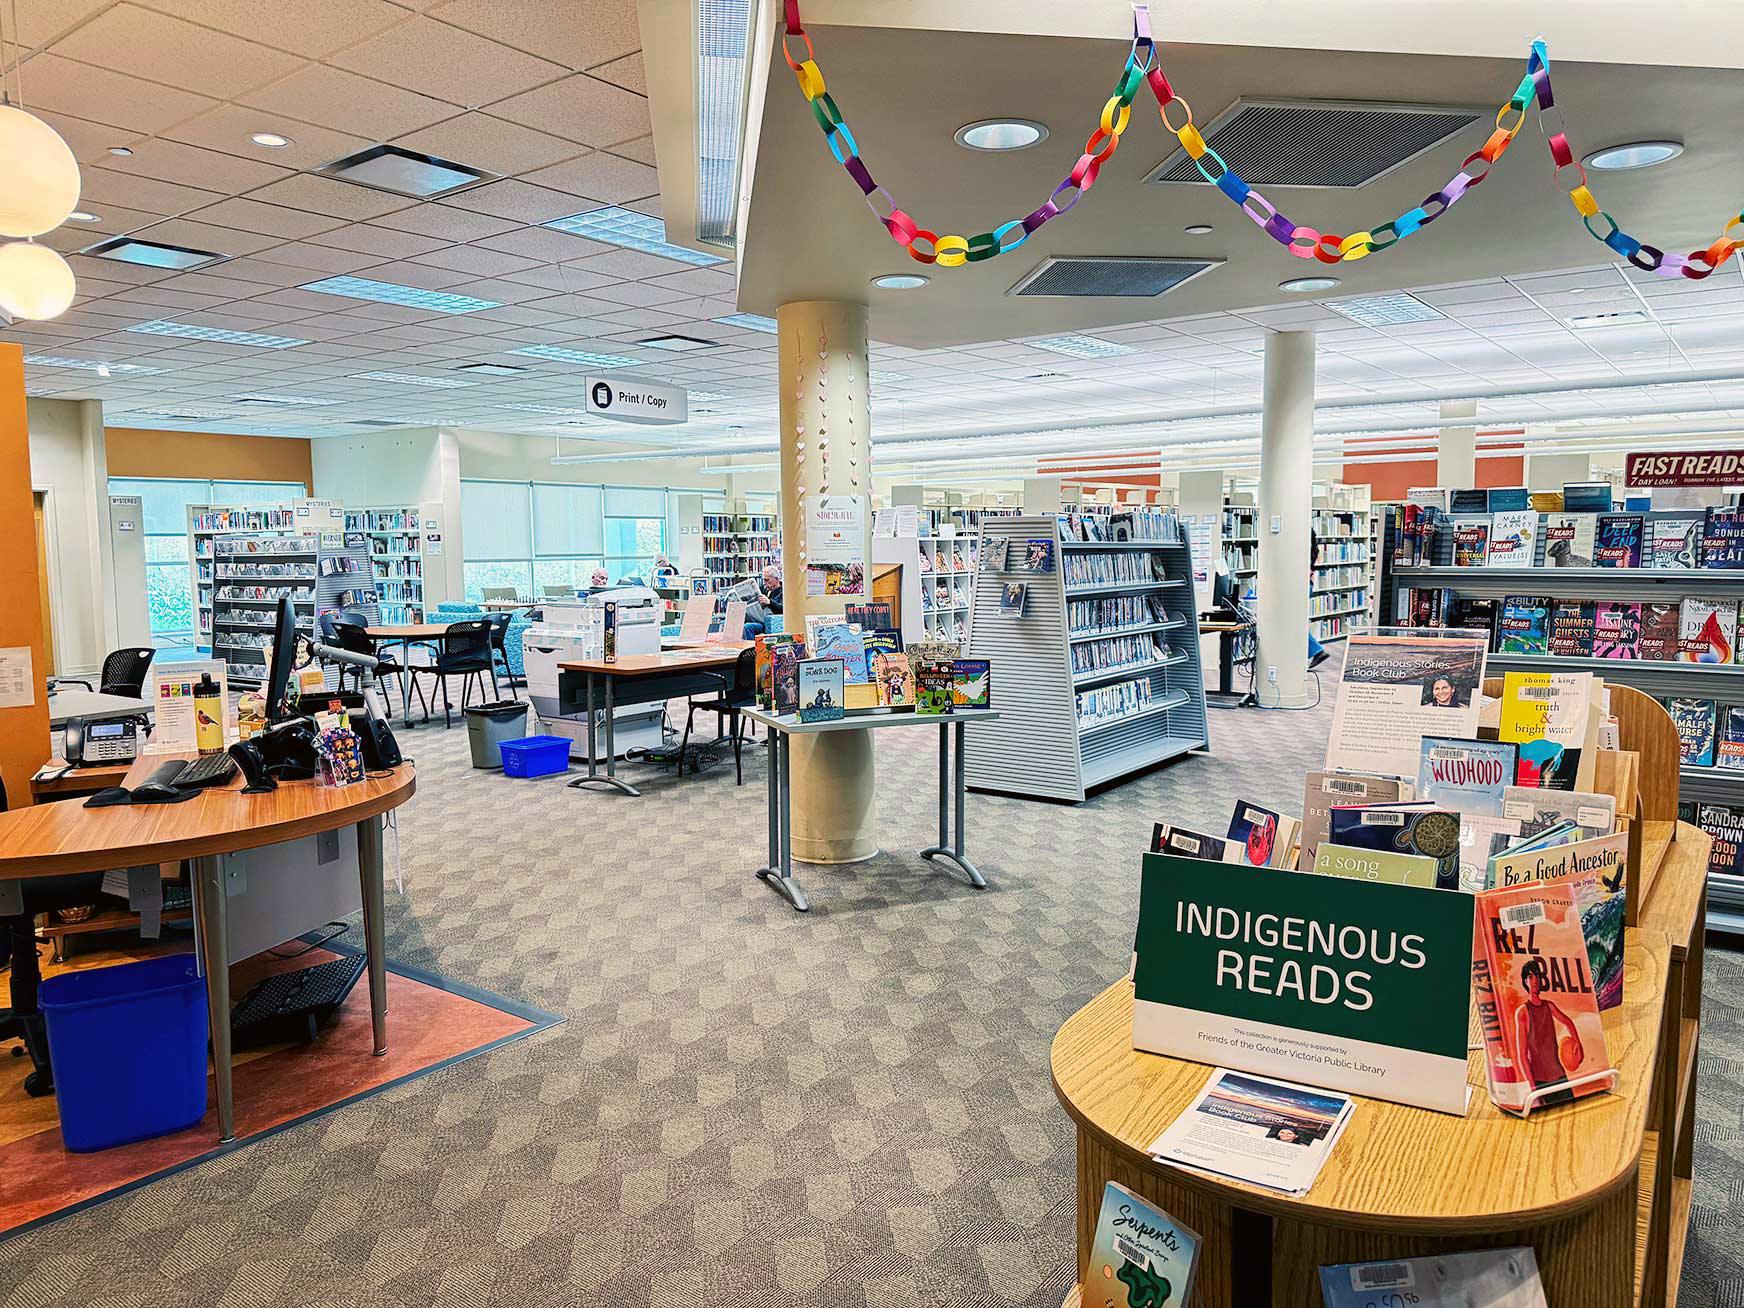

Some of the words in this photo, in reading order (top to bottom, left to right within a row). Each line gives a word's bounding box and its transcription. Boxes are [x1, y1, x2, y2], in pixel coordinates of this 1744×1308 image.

[619, 392, 640, 404] Print
[642, 394, 645, 404] /
[647, 395, 667, 408] Copy
[1631, 457, 1682, 475] FAST
[1681, 456, 1744, 474] READS
[1631, 477, 1638, 485] 7
[1733, 514, 1744, 522] RO
[1603, 524, 1640, 538] DEEP
[1610, 536, 1638, 548] END
[1568, 610, 1581, 618] THE
[1554, 618, 1593, 627] SUMMER
[1688, 622, 1734, 633] DRM
[1556, 628, 1589, 638] GUESTS
[824, 667, 838, 675] DOG
[1354, 658, 1411, 669] Indigenous
[1414, 660, 1450, 670] Stories
[1353, 668, 1380, 677] Book
[1382, 670, 1406, 678] Club
[1536, 702, 1560, 711] truth
[1541, 712, 1552, 723] &
[1677, 720, 1706, 728] MALFI
[1516, 723, 1545, 736] bright
[1548, 726, 1573, 734] water
[1678, 728, 1702, 736] URSE
[1431, 758, 1502, 785] WILDHOOD
[1701, 811, 1744, 829] SANDRA
[1712, 842, 1737, 854] OOD
[1321, 855, 1329, 867] a
[1335, 856, 1380, 879] song
[1504, 865, 1521, 886] Be
[1524, 871, 1531, 881] a
[1536, 858, 1566, 880] Good
[1570, 848, 1619, 874] Ancestor
[1176, 901, 1426, 969] INDIGENOUS
[1490, 917, 1540, 955] REZ
[1216, 950, 1374, 1011] READS
[1472, 959, 1493, 993] REZ
[1533, 956, 1592, 993] BALL
[1480, 1001, 1502, 1042] BALL
[1234, 1028, 1245, 1036] This
[1246, 1031, 1272, 1040] collection
[1279, 1037, 1309, 1048] generously
[1310, 1042, 1339, 1053] supported
[1198, 1032, 1228, 1044] Friends
[1230, 1039, 1239, 1047] of
[1240, 1040, 1254, 1049] the
[1256, 1043, 1288, 1056] Greater
[1289, 1049, 1322, 1063] Victoria
[1324, 1056, 1352, 1069] Public
[1354, 1062, 1386, 1077] Library
[1208, 1107, 1233, 1117] Book
[1234, 1114, 1257, 1122] Club
[1212, 1102, 1262, 1119] Indigenous
[1264, 1115, 1298, 1126] Stories
[1113, 1205, 1179, 1251] Serpents
